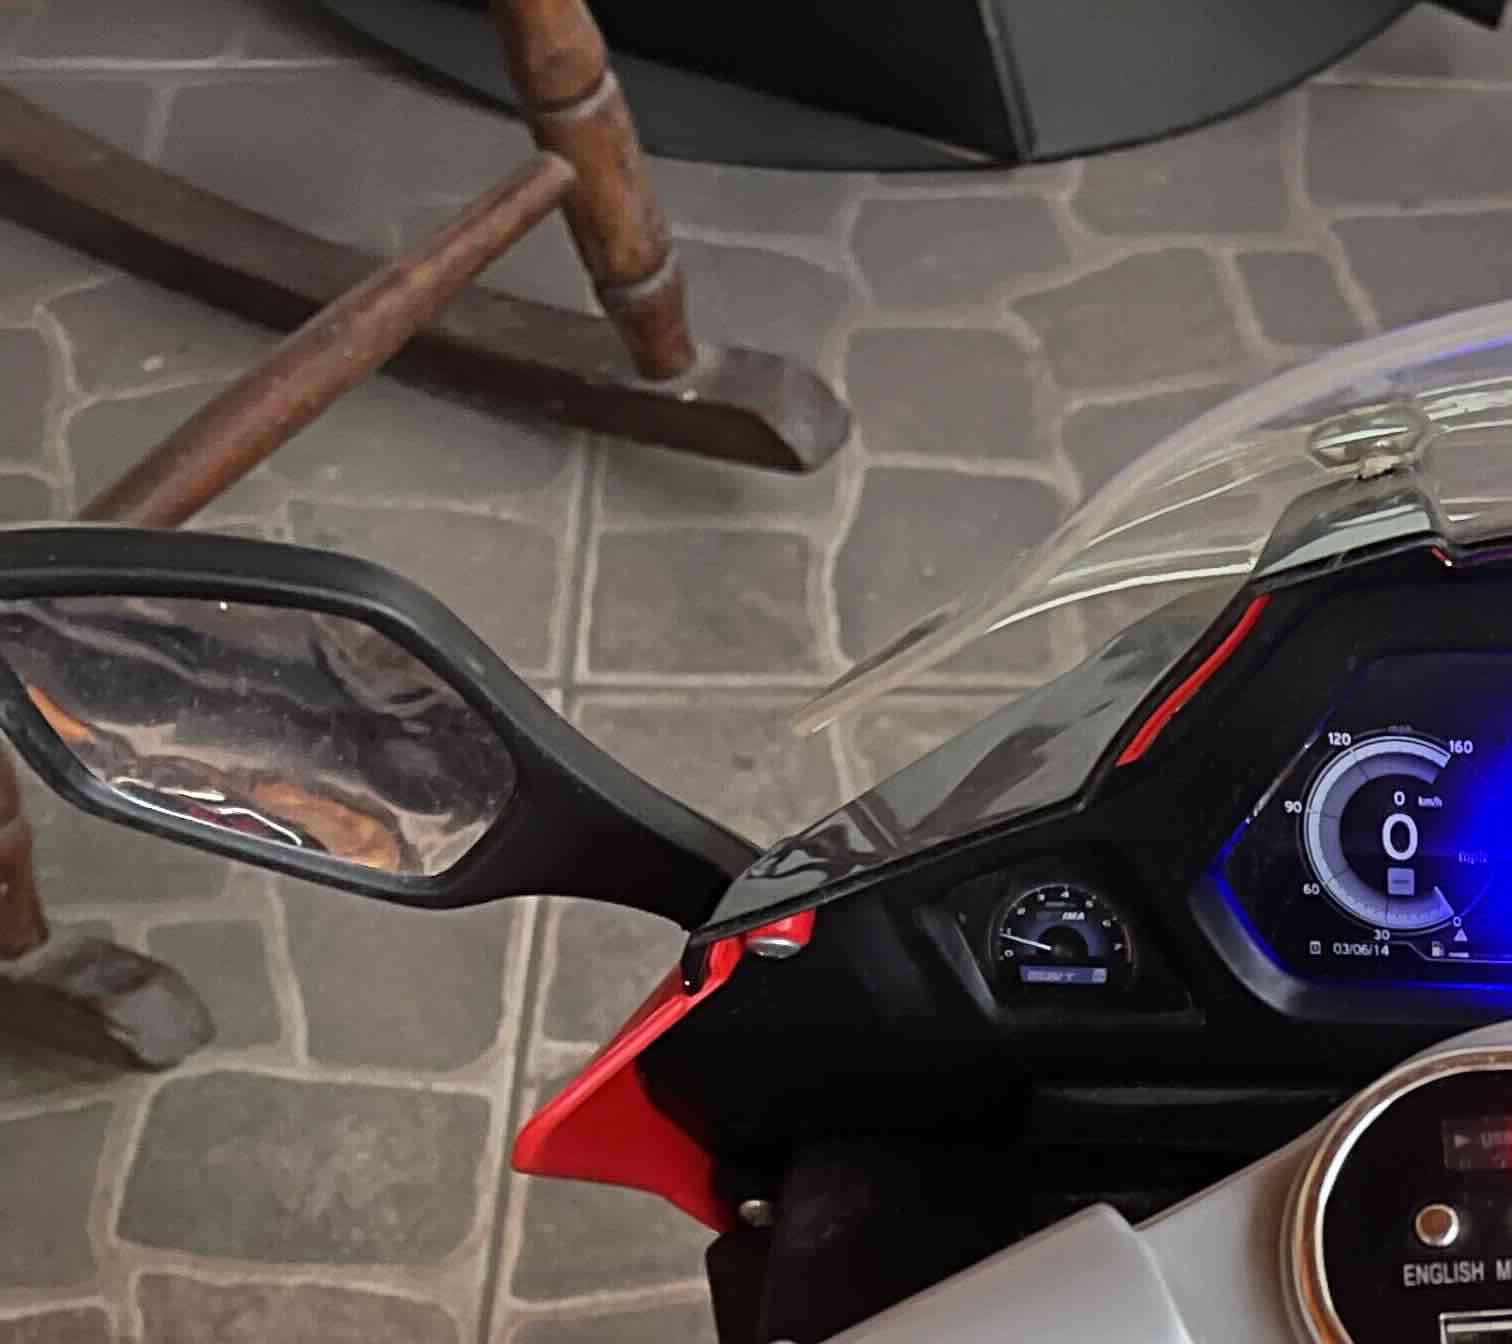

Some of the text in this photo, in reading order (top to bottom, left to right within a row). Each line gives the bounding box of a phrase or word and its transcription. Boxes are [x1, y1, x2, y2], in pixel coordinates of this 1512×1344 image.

[1328, 732, 1351, 746] 120
[1449, 740, 1473, 754] 160
[1394, 791, 1405, 806] 0
[1284, 801, 1302, 813] 90
[1382, 813, 1418, 861] 0
[1303, 884, 1320, 895] 60
[1453, 916, 1462, 928] 0
[1373, 929, 1390, 941] 30
[1333, 943, 1390, 957] 03/06/14
[1403, 1261, 1485, 1287] ENGLISH
